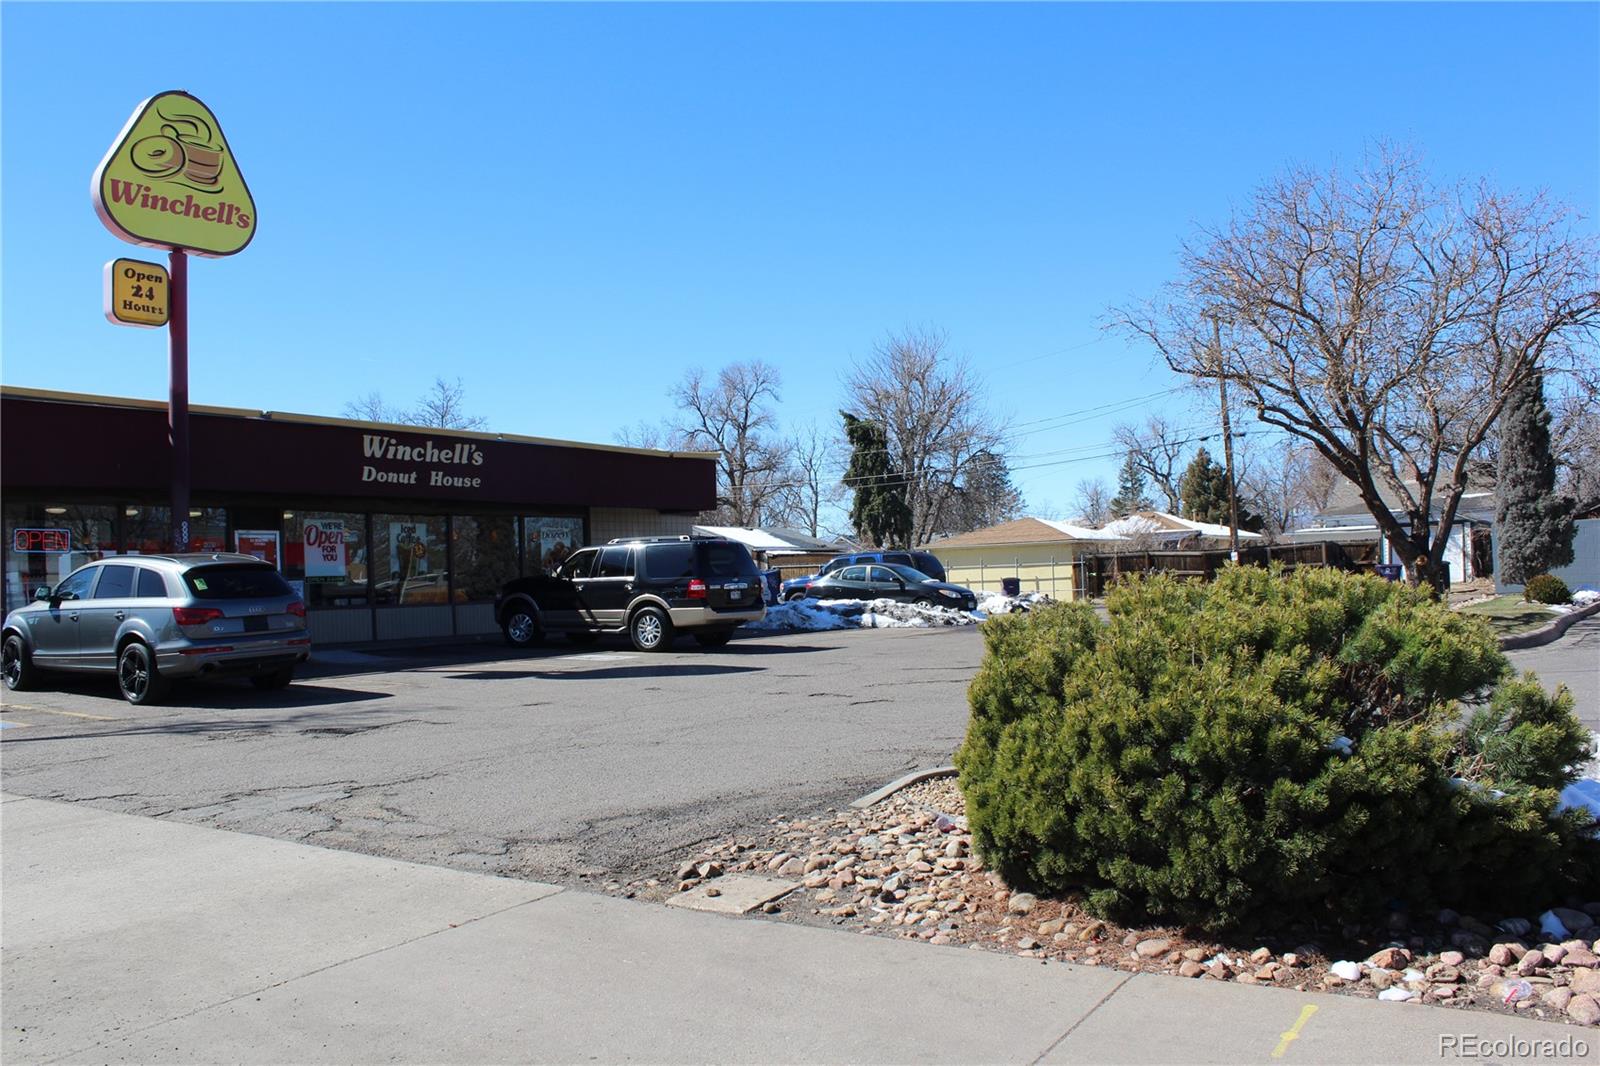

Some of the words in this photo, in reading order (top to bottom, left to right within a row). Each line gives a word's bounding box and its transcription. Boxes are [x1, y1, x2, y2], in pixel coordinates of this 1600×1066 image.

[110, 178, 250, 229] Winchell's
[124, 267, 163, 284] Open
[131, 284, 155, 301] 24
[122, 299, 165, 316] Hours
[362, 434, 484, 466] Winchell's
[362, 466, 417, 485] Donut
[429, 471, 482, 488] House
[15, 530, 68, 551] OPEN
[304, 524, 345, 548] Open
